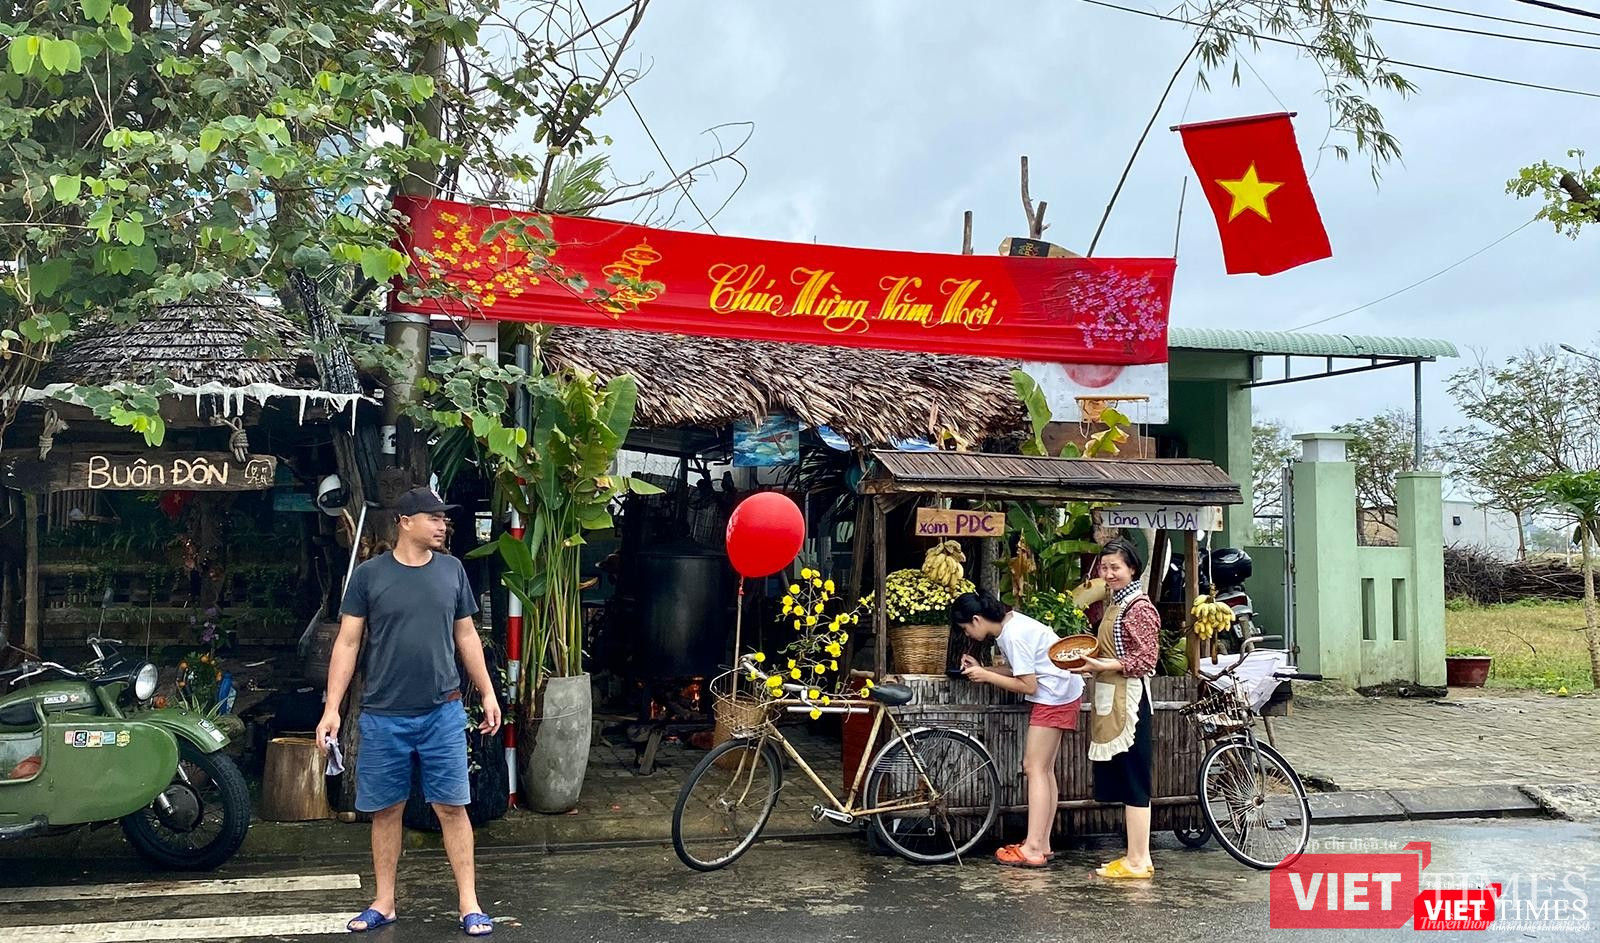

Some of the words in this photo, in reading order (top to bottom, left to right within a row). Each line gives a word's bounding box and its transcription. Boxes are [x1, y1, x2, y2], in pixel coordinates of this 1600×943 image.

[708, 263, 789, 317] Chúc
[790, 267, 870, 333] Mừng
[873, 276, 938, 328] Năm
[940, 278, 1003, 331] Mới
[88, 455, 165, 489] Buôn
[170, 457, 229, 485] ĐÔN
[919, 517, 949, 534] xóm
[956, 514, 995, 534] PDC
[1145, 507, 1167, 529] VŨ
